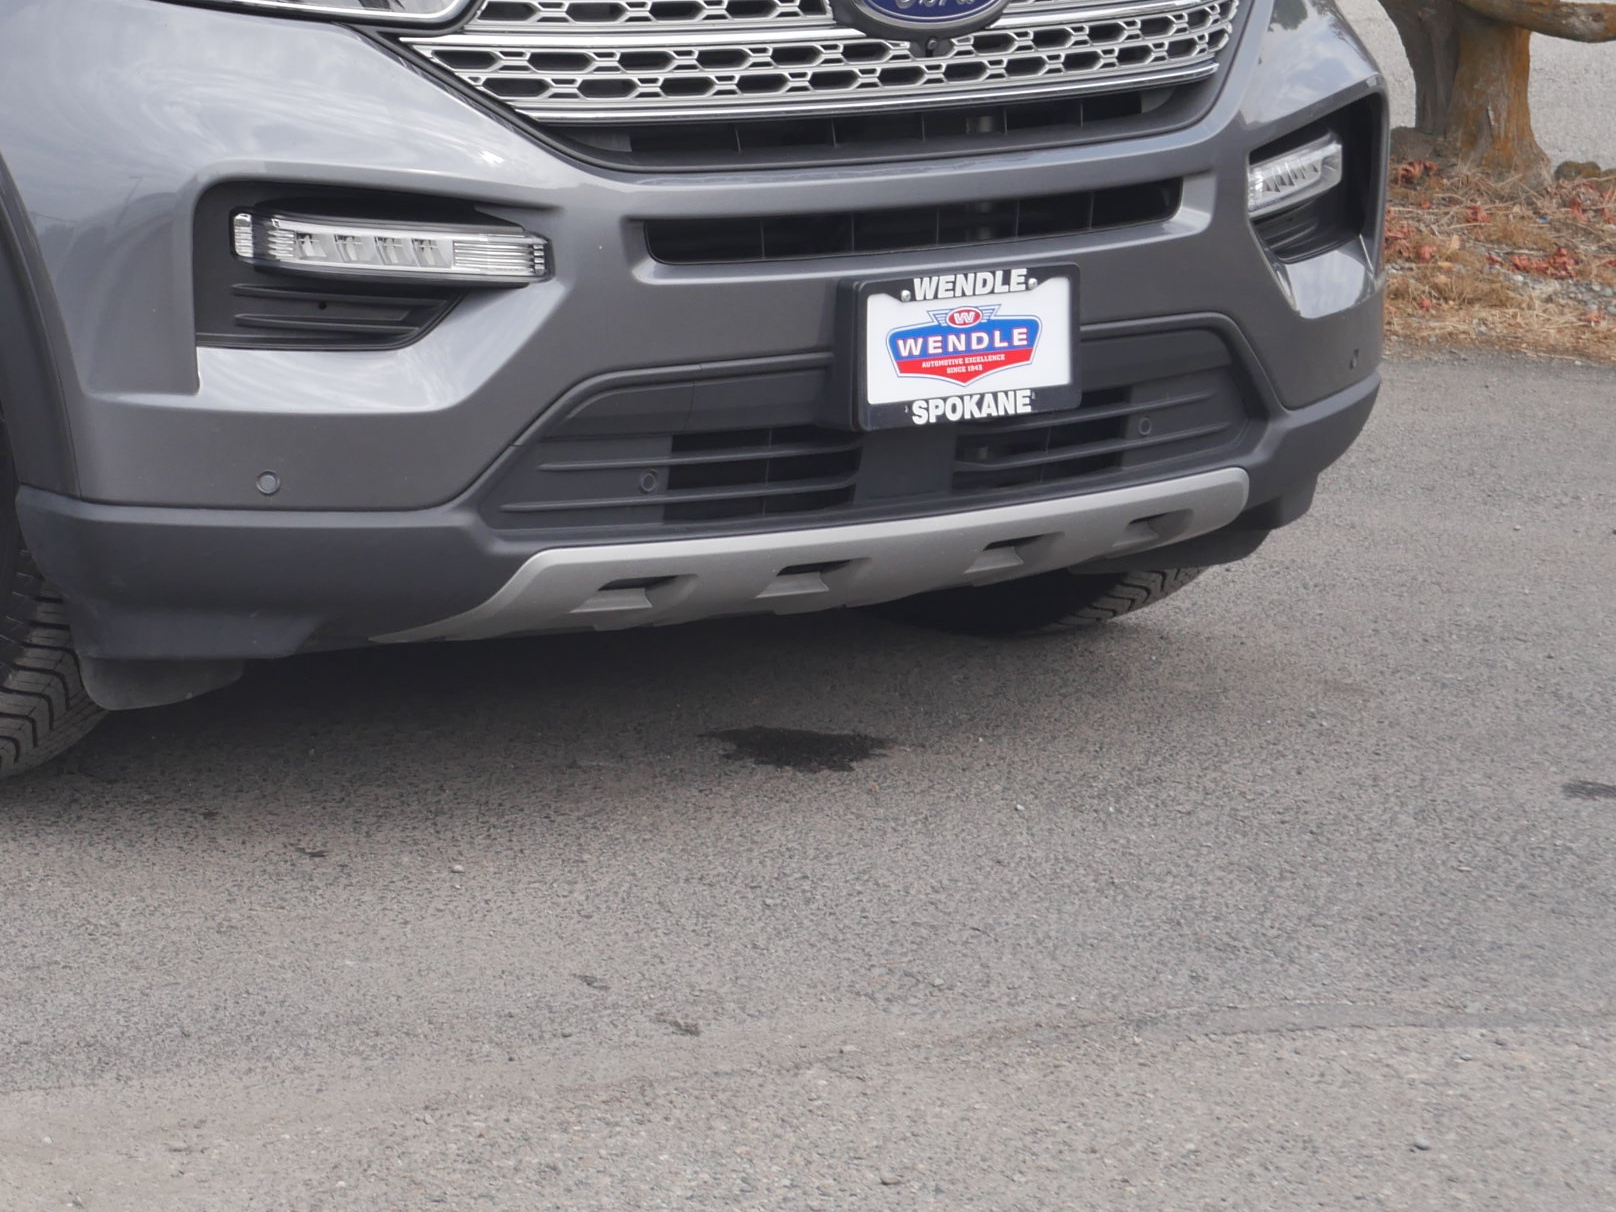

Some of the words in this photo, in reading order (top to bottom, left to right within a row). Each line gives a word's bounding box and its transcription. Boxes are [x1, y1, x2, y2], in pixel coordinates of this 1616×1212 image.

[912, 268, 1028, 301] WENDLE
[897, 326, 1029, 358] WENDLE
[921, 356, 964, 368] AUTOMOTIVE
[964, 353, 1006, 365] EXCELLENCE
[946, 365, 967, 375] SINCE
[911, 389, 1032, 425] SPOKANE
